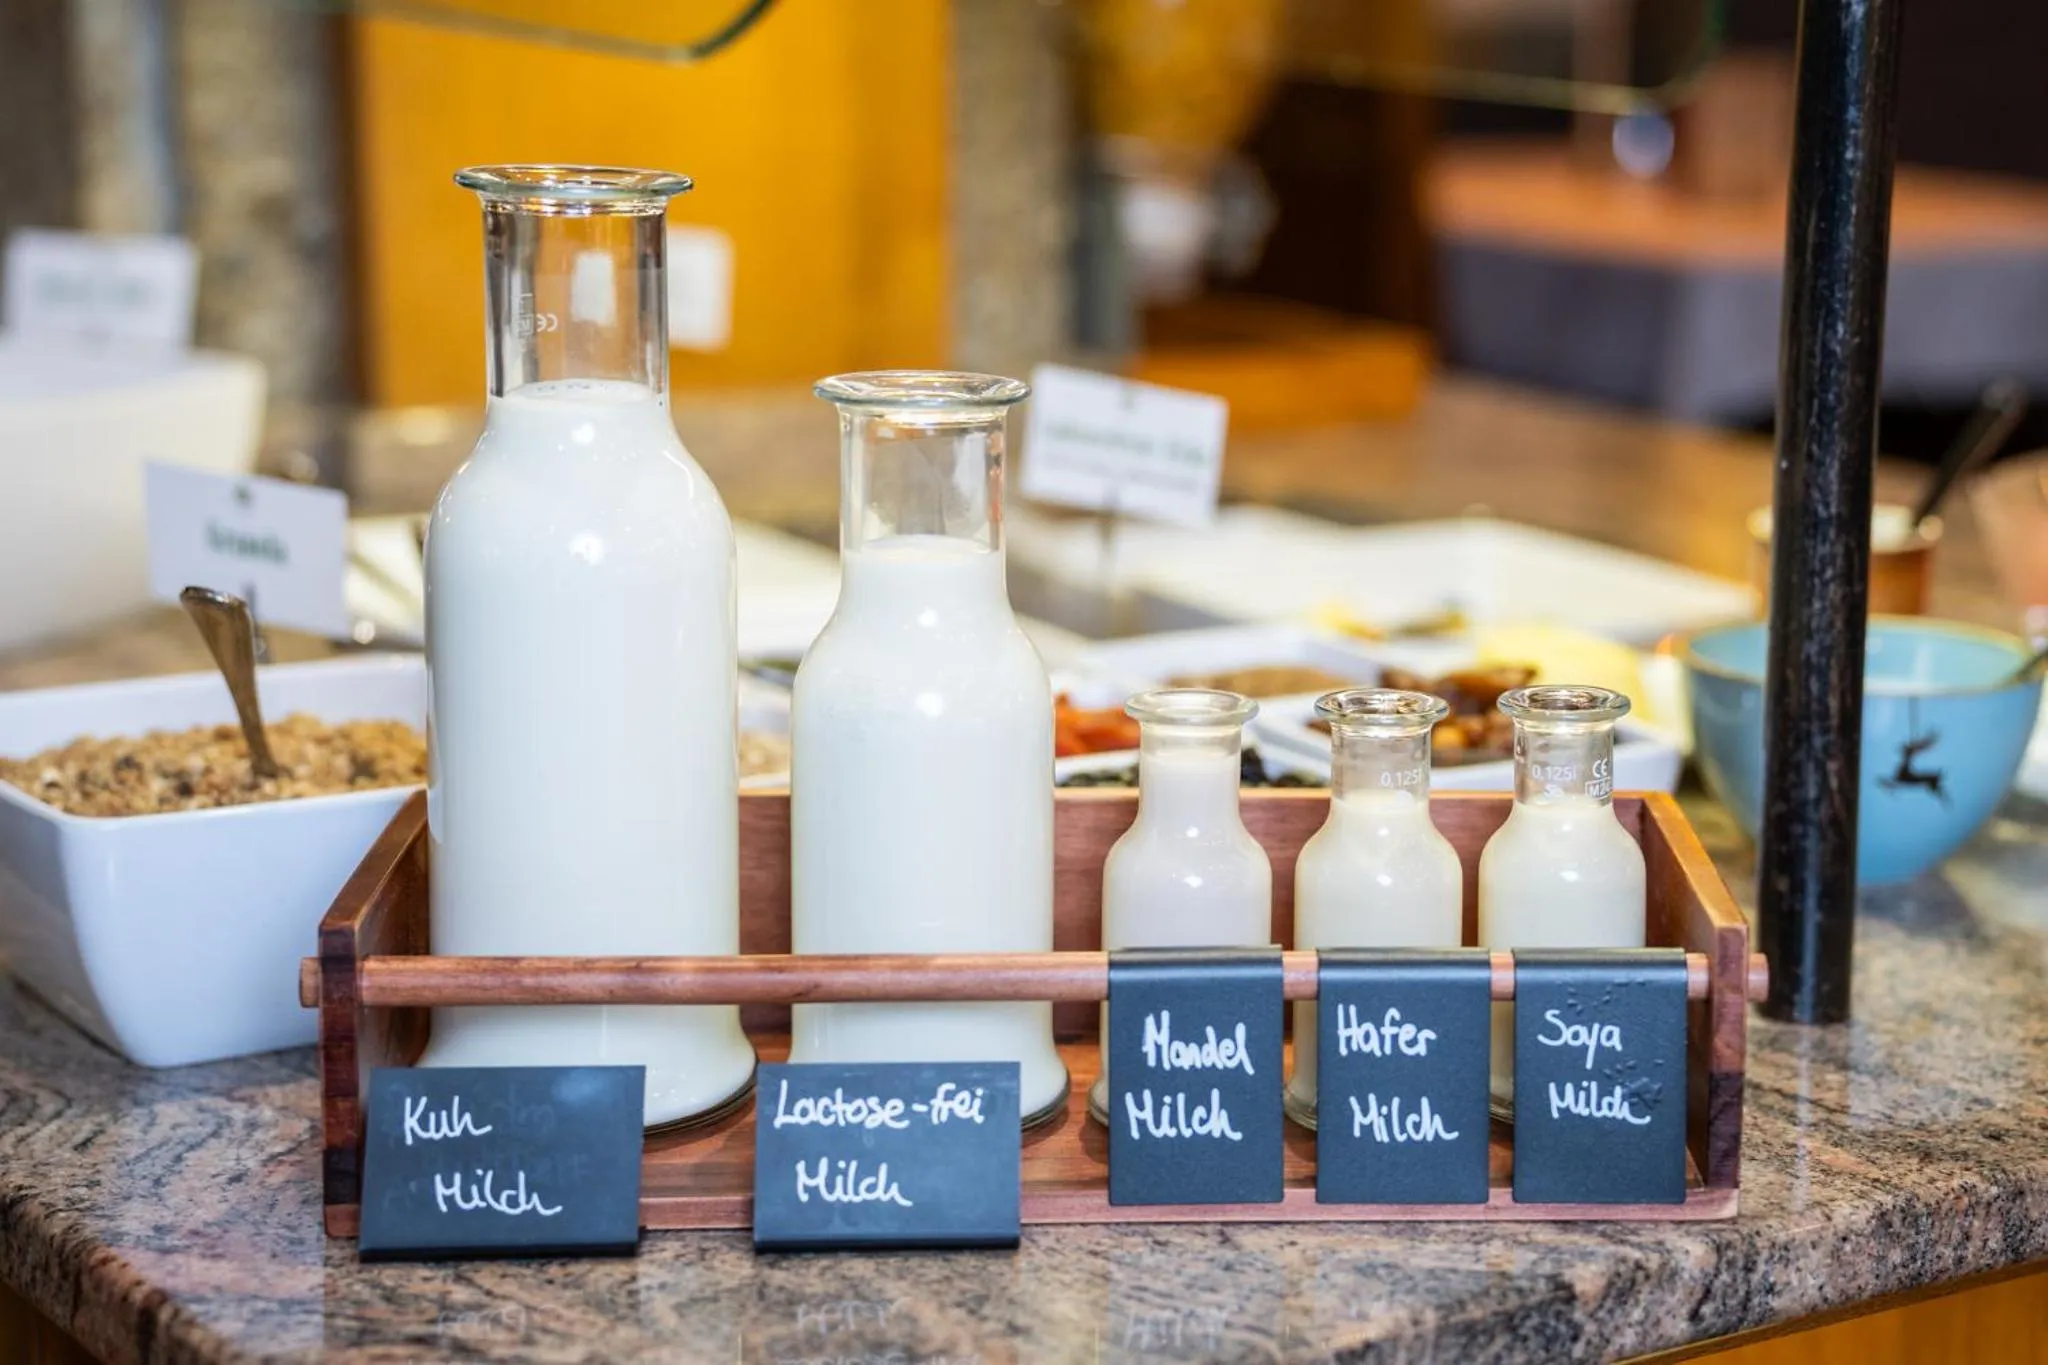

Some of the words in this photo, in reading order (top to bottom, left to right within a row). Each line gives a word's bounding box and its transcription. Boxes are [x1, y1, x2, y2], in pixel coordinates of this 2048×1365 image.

[1142, 1009, 1255, 1076] Mandel
[1336, 1003, 1438, 1058] Hafer
[1537, 1009, 1622, 1070] Soya
[403, 1095, 493, 1146] Kuh
[773, 1079, 985, 1129] Lactose-frei
[1124, 1088, 1243, 1141] Milch
[1349, 1093, 1460, 1144] Milch
[1548, 1080, 1652, 1126] Milch
[434, 1168, 563, 1217] Milch
[795, 1156, 914, 1207] Milch
